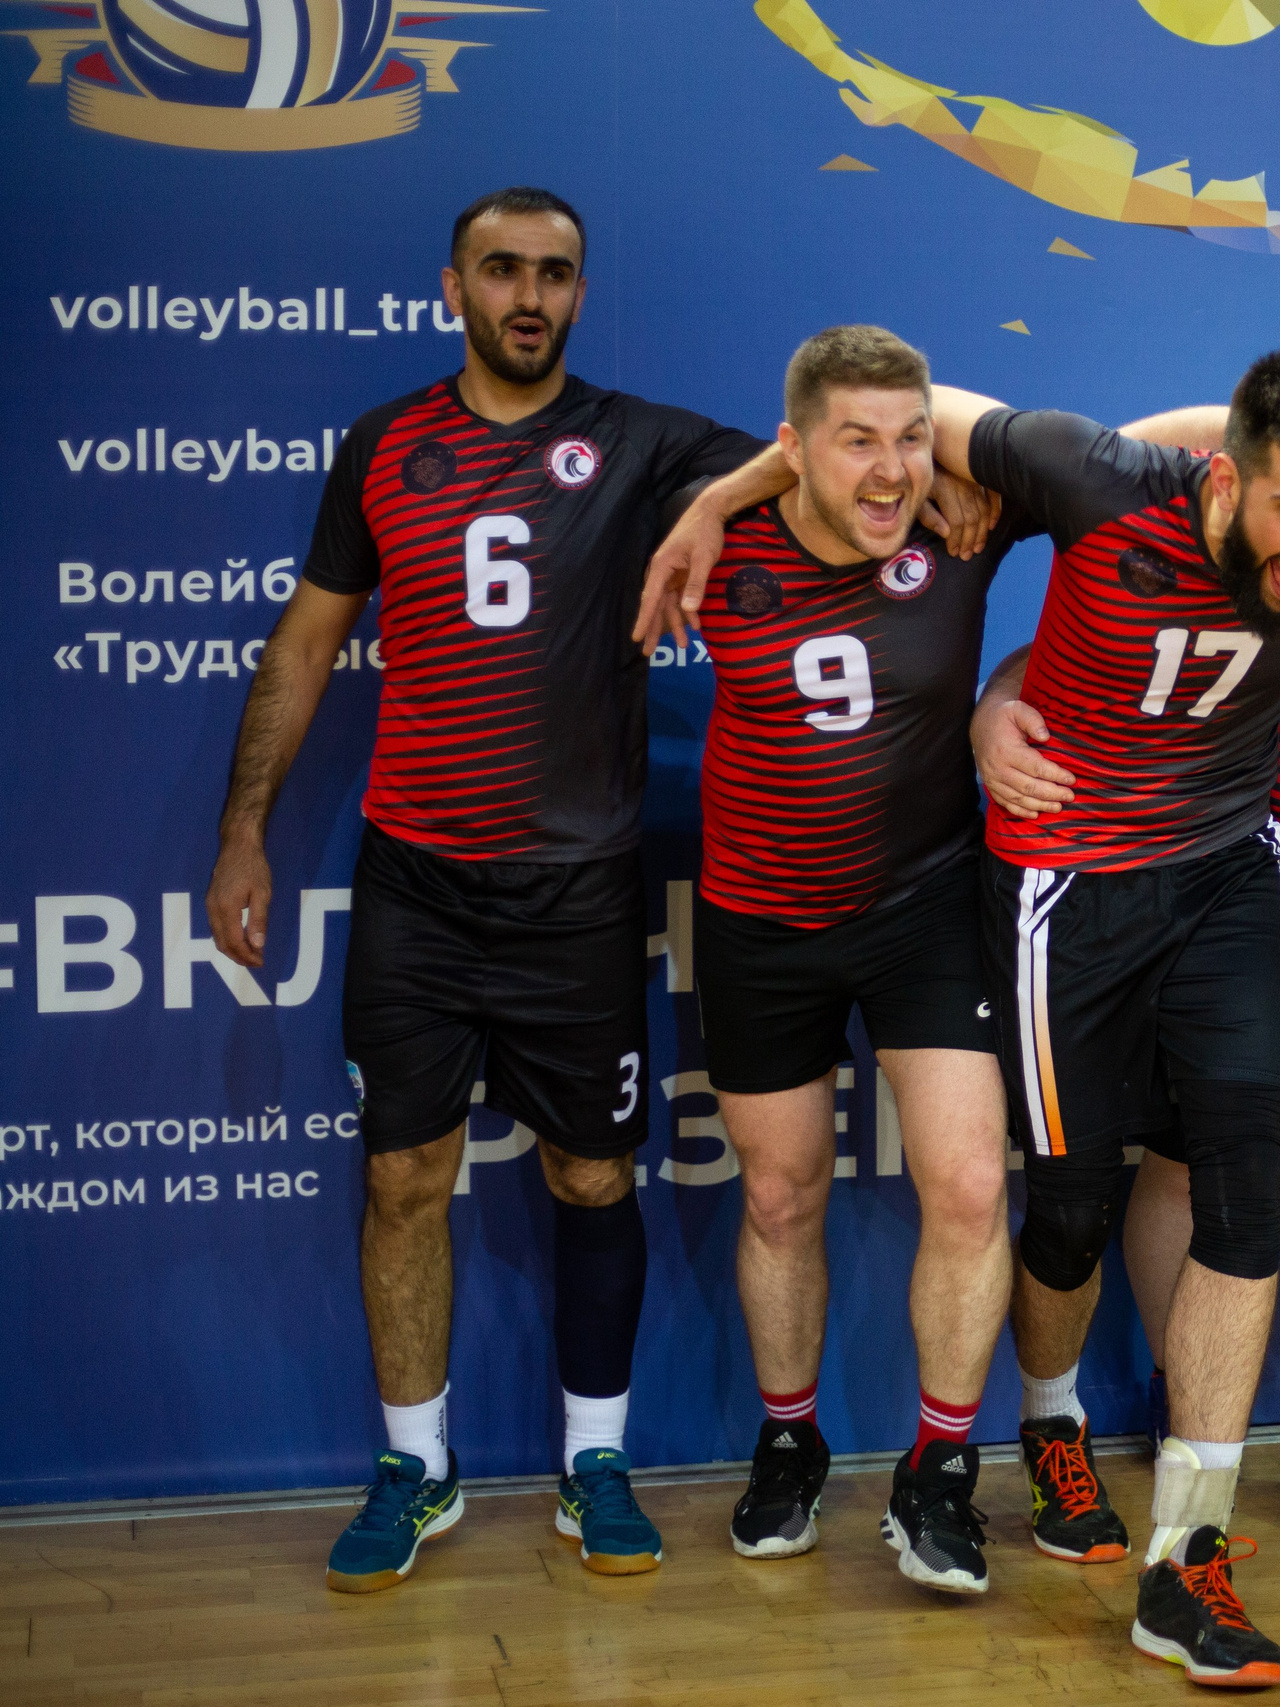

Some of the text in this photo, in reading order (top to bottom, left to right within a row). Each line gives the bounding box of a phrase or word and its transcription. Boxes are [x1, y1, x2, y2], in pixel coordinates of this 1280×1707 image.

[58, 428, 350, 482] volleybal
[465, 515, 531, 627] 6
[793, 635, 873, 732] 9
[1141, 628, 1264, 718] 17
[613, 1052, 640, 1123] 3
[75, 1105, 288, 1153] который
[0, 1170, 320, 1213] ждом из нас
